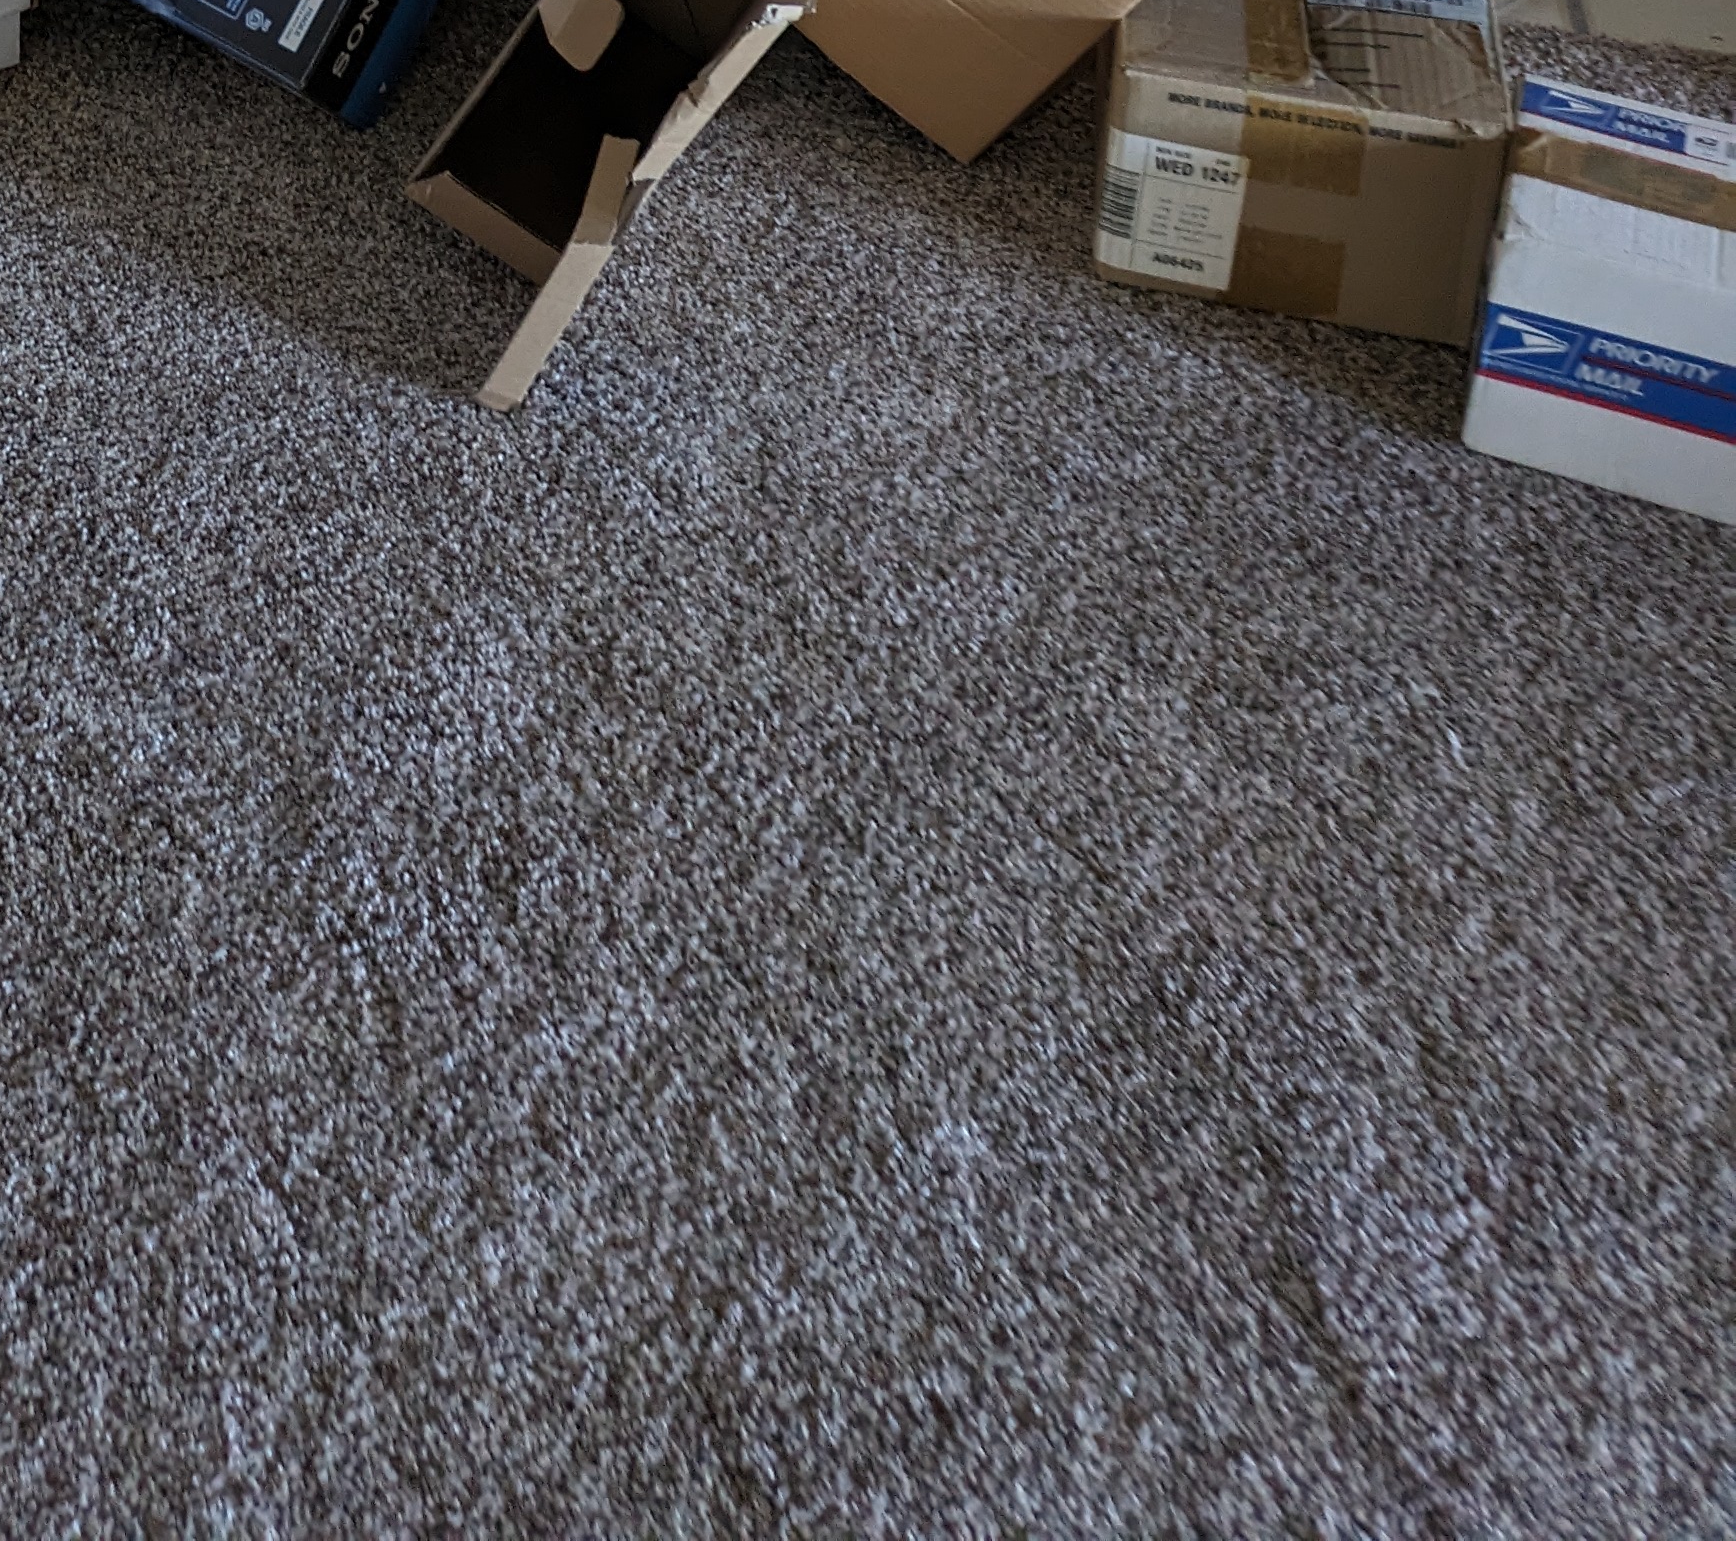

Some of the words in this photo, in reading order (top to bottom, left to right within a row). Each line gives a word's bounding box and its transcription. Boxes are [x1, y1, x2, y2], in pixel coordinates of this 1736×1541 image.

[1167, 91, 1202, 108] MORE
[1155, 155, 1194, 177] WED
[1201, 160, 1242, 186] 1247
[1587, 337, 1720, 385] PRIORITY
[1574, 364, 1644, 398] MAIL
